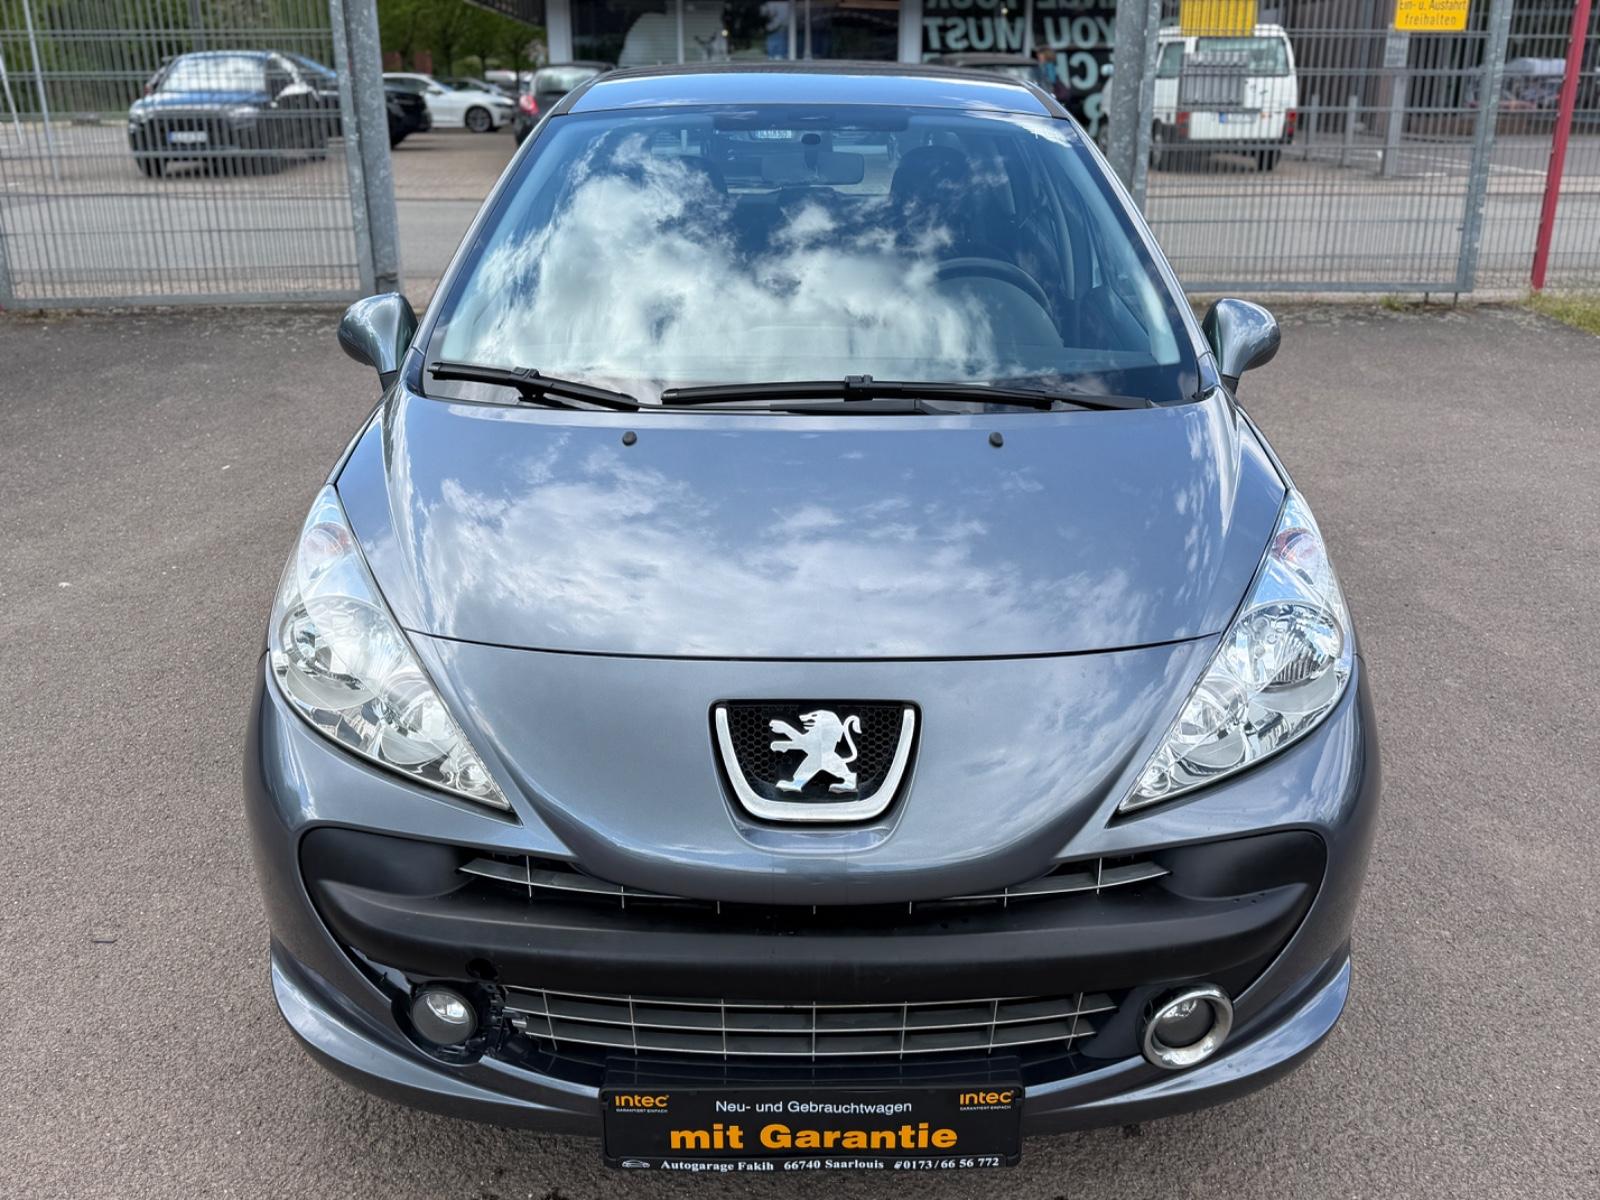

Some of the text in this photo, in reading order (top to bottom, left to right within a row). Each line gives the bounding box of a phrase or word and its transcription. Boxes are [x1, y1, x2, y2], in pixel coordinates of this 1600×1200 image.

[1405, 14, 1457, 25] freihalten
[715, 1100, 913, 1115] Neu- und Gebrauchtwagen
[670, 1122, 958, 1150] mit Garantie
[660, 1160, 735, 1173] Autogarage
[738, 1161, 774, 1172] Fakih
[783, 1160, 821, 1171] 66740
[825, 1159, 885, 1170] Saarlouis
[959, 1158, 975, 1169] 56
[978, 1157, 1000, 1168] 772
